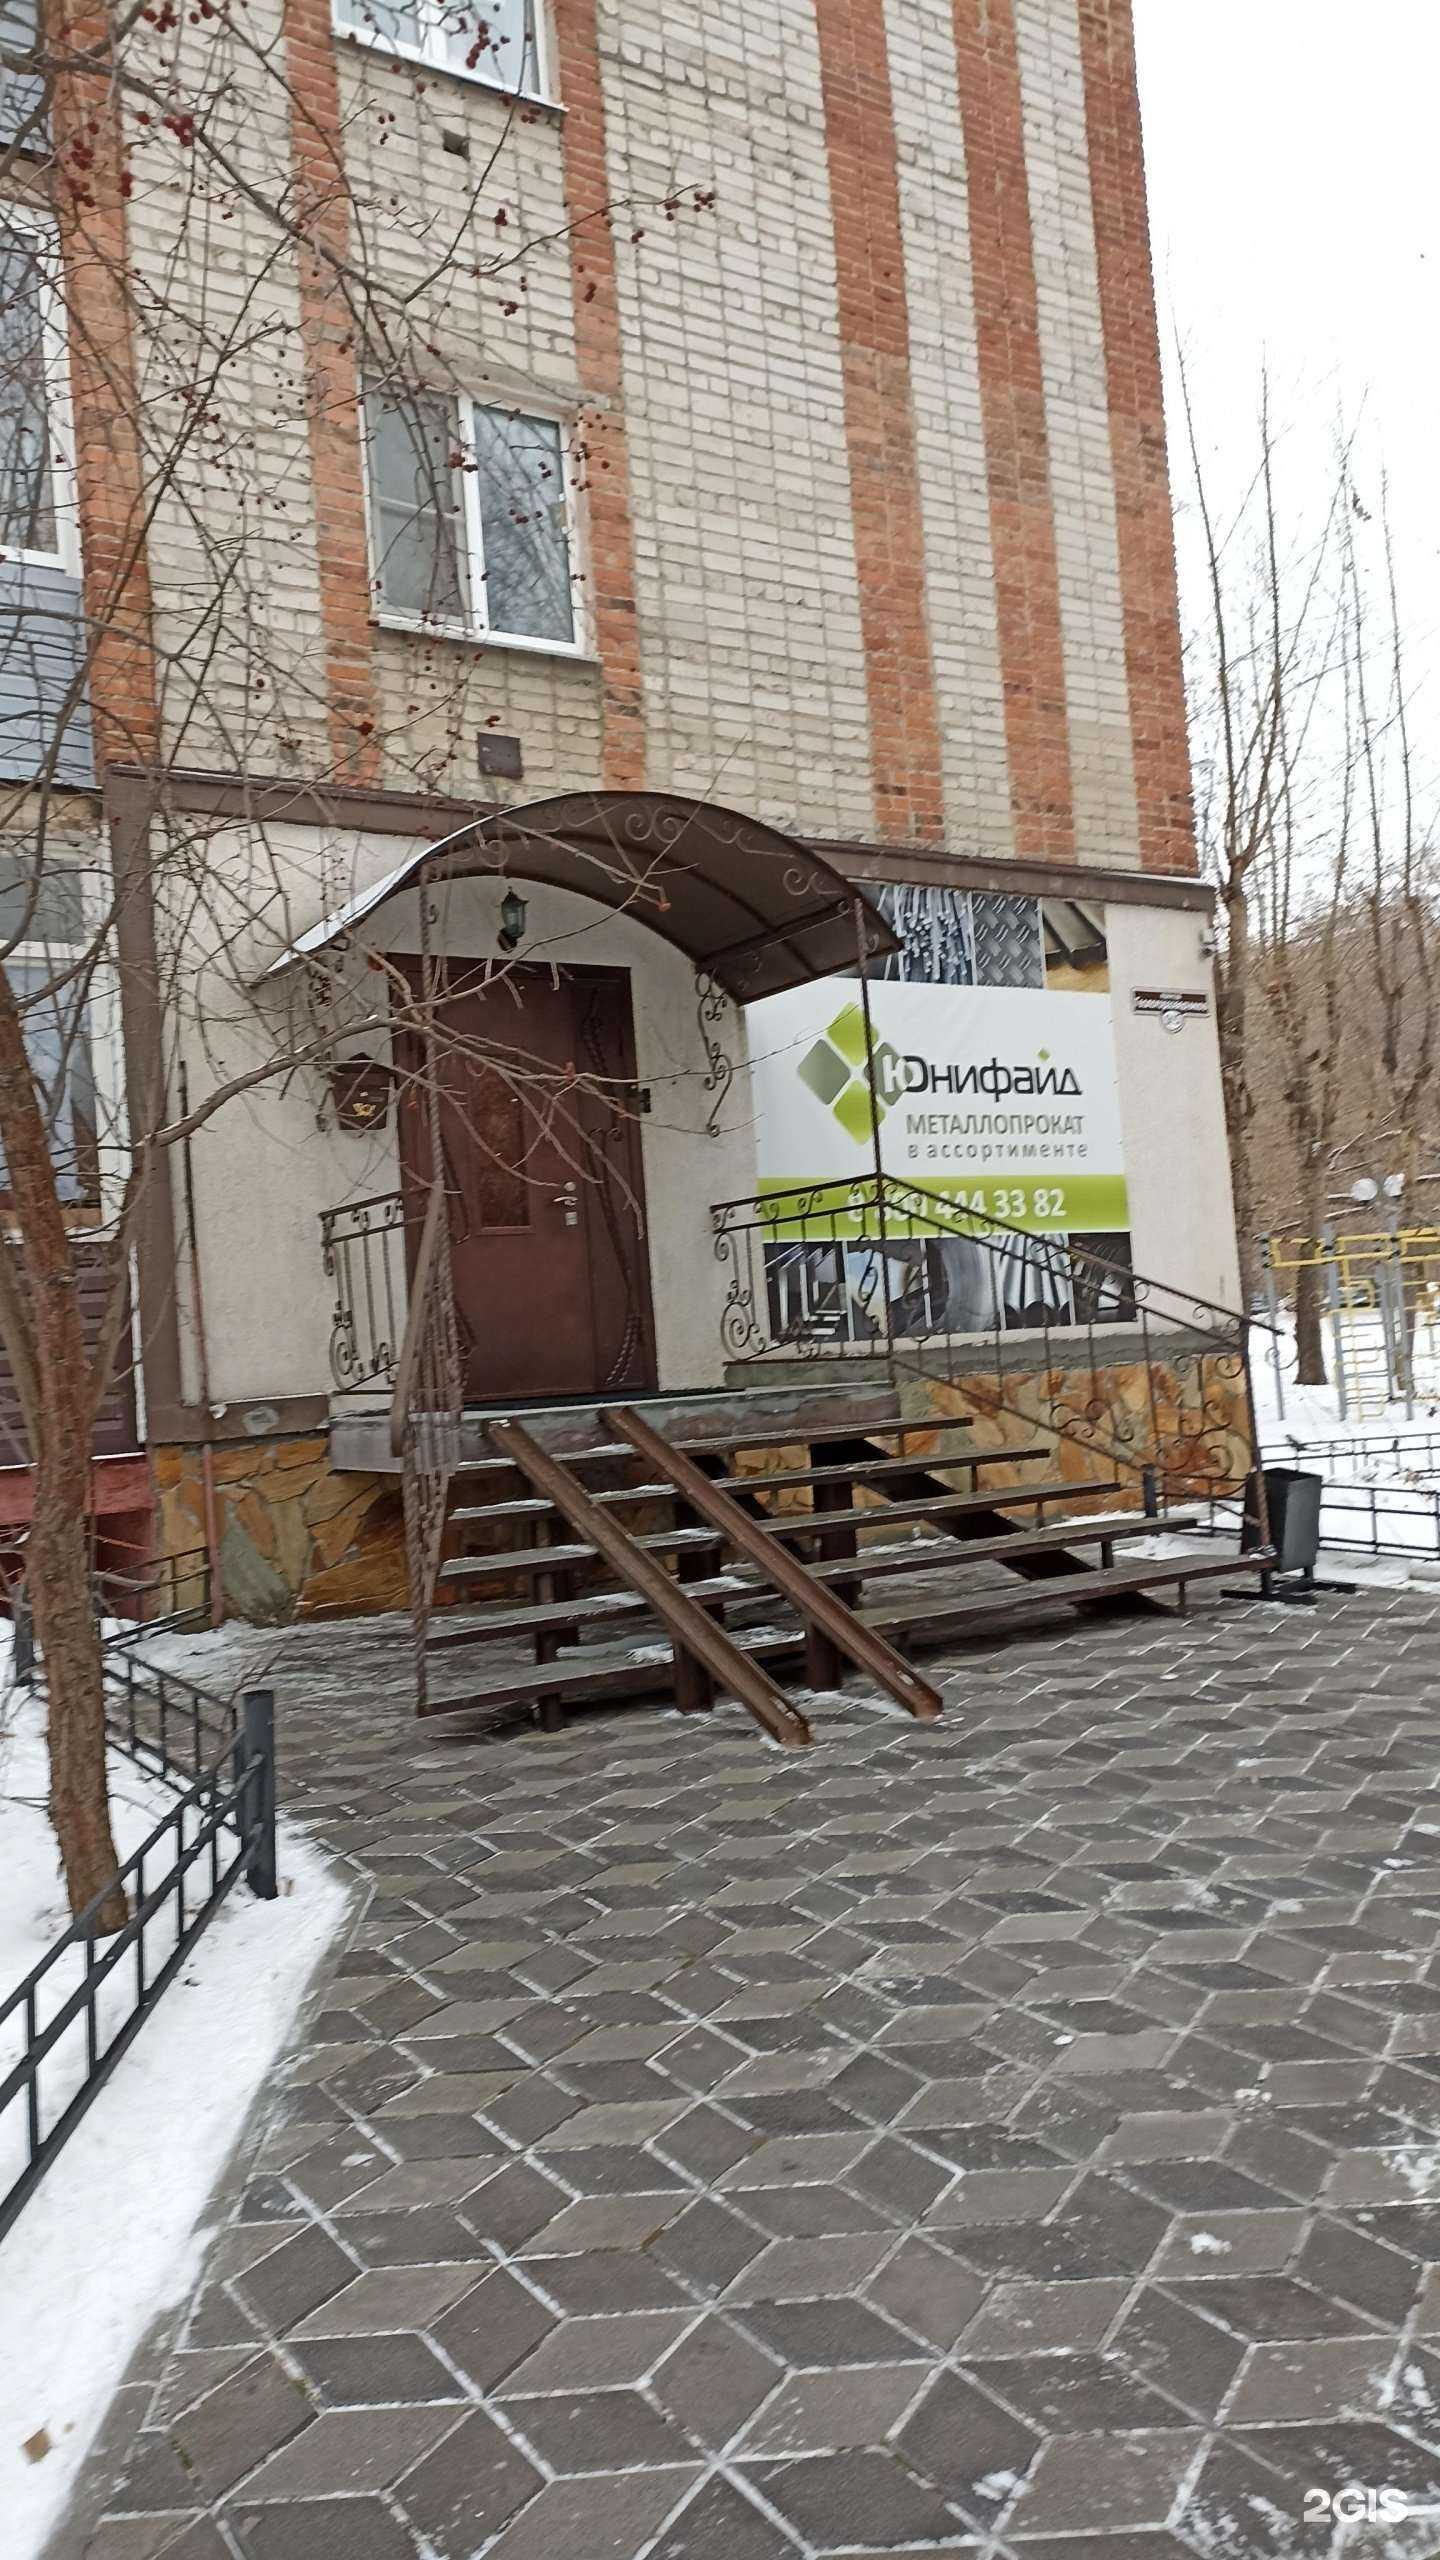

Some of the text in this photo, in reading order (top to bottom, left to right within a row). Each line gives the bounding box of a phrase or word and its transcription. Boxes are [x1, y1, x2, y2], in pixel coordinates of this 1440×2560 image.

[881, 1049, 1083, 1102] Юнифайд
[906, 1113, 1085, 1135] МЕТАЛЛОПРОКАТ
[907, 1142, 1089, 1162] в ассортименте
[934, 1189, 987, 1219] 444
[993, 1188, 1028, 1218] 33
[1033, 1187, 1067, 1217] 82
